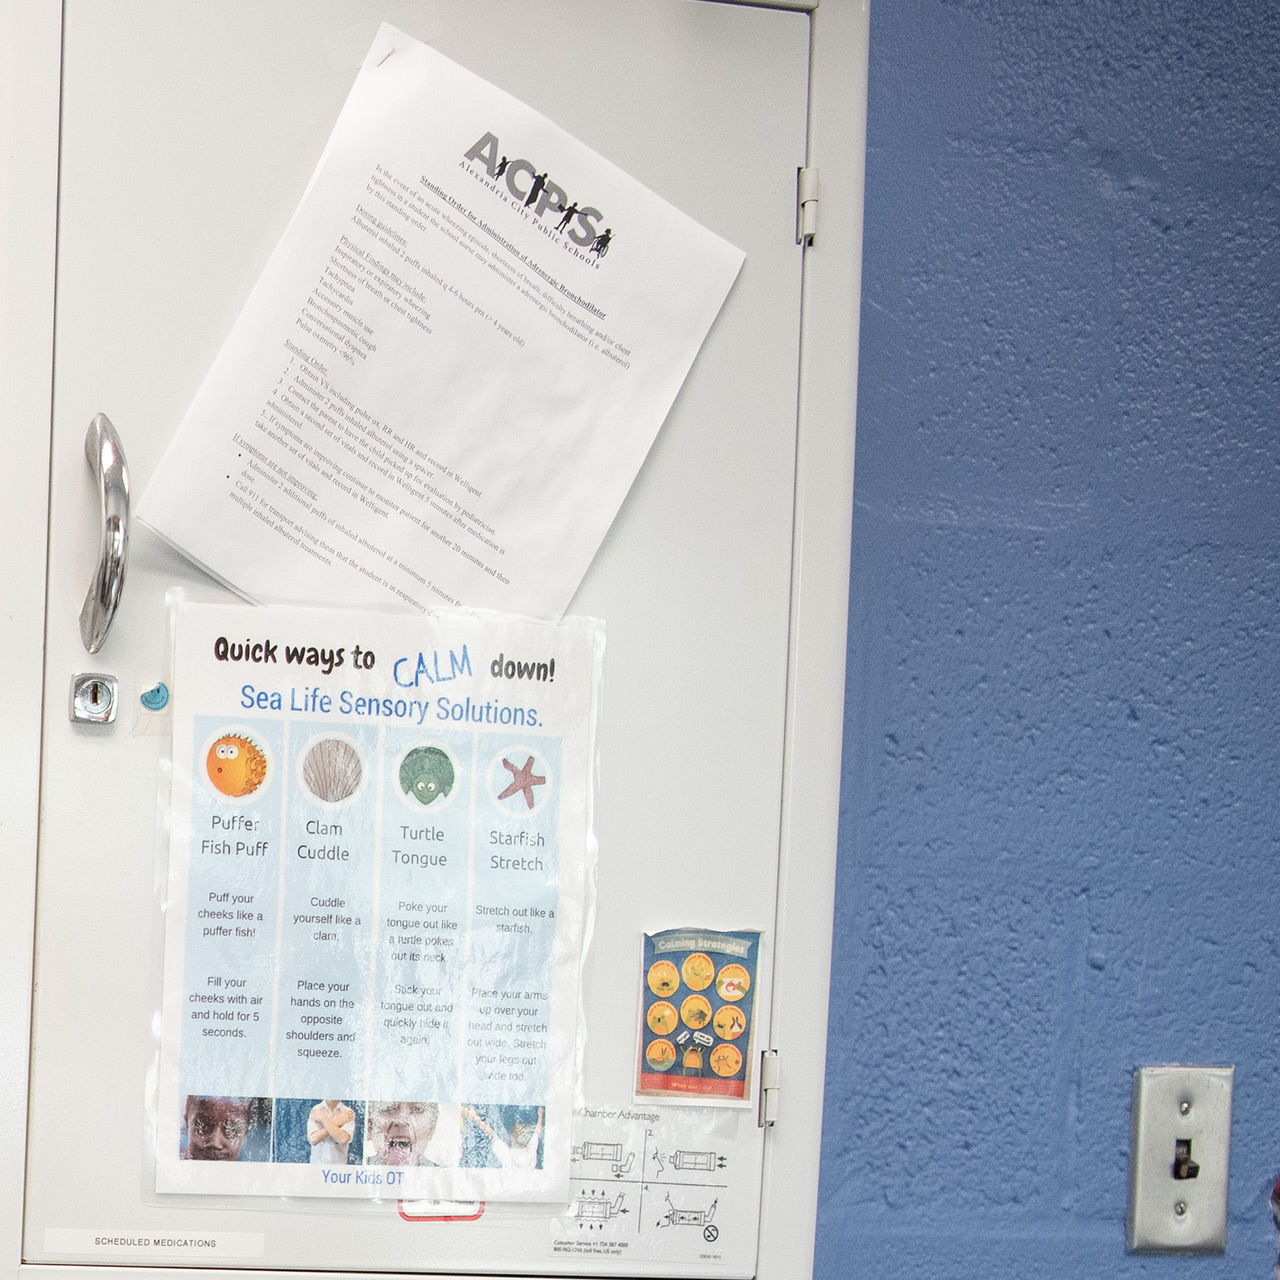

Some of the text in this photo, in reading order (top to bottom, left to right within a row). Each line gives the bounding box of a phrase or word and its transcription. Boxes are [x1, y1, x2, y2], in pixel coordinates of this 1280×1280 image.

[463, 131, 604, 247] ACPS
[458, 161, 600, 269] Alexandria City Public Schools
[213, 636, 556, 689] Quick ways to CALM down!
[240, 684, 544, 728] Sea Life Sensory Solutions.
[211, 814, 260, 833] Puffer
[305, 819, 343, 836] Clam
[400, 825, 445, 843] Turtle
[489, 830, 545, 848] Starfish
[201, 840, 269, 858] Fish Puff
[297, 845, 350, 862] Cuddle
[392, 850, 447, 868] Tongue
[490, 855, 544, 872] Stretch
[659, 939, 744, 953] Calming Strategies
[322, 1169, 403, 1186] Your Kids OT
[95, 1237, 216, 1247] SCHEDULED MEDICATIONS
